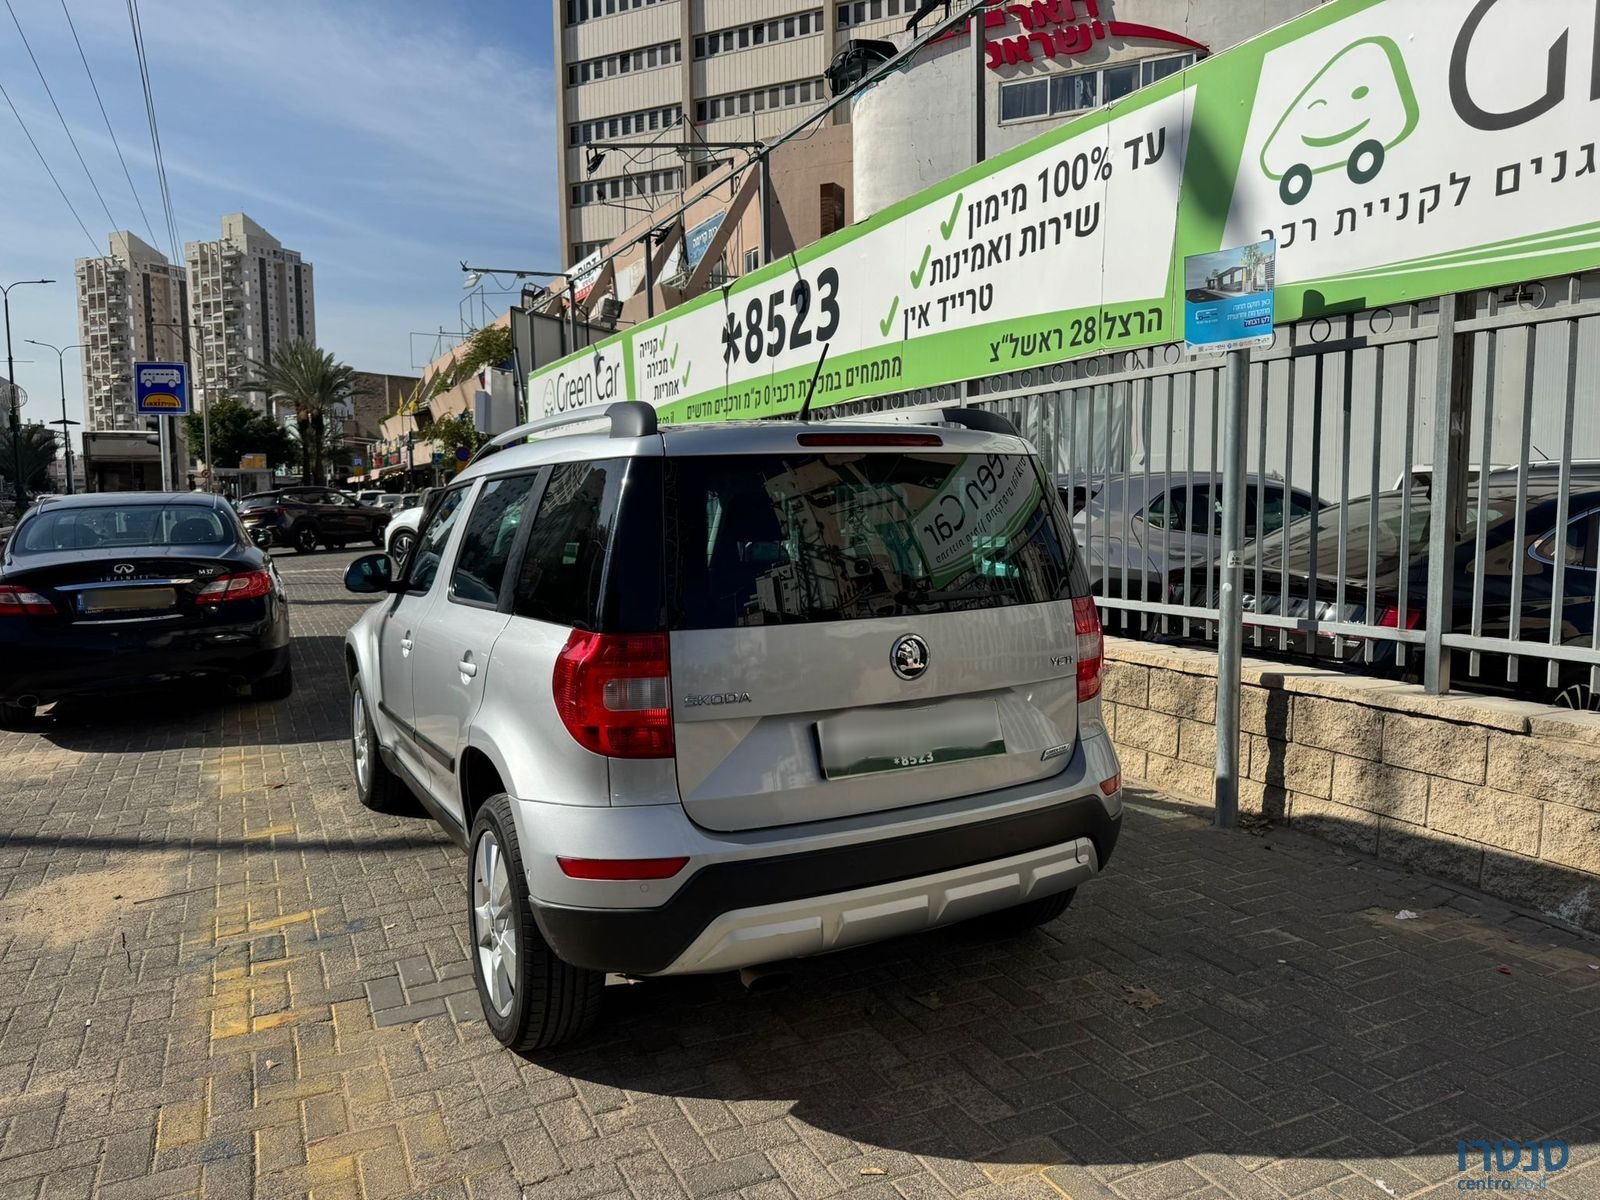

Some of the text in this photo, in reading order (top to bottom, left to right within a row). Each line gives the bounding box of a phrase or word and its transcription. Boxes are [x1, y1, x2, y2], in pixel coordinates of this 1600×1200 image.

[968, 127, 1166, 240] עד 100% מימון
[1334, 171, 1471, 237] לקניית
[930, 202, 1100, 286] שירות ואמינות
[904, 283, 993, 340] טרייד אין
[1103, 307, 1163, 340] הרצל
[1069, 316, 1096, 347] 28
[640, 337, 658, 358] קנייה
[557, 355, 620, 412] Green Car
[646, 358, 668, 378] מכירה
[846, 356, 902, 387] מתמחים
[653, 378, 679, 400] אחריות
[772, 383, 795, 404] רכבי
[798, 373, 842, 397] במכרת
[687, 400, 713, 419] חדשים
